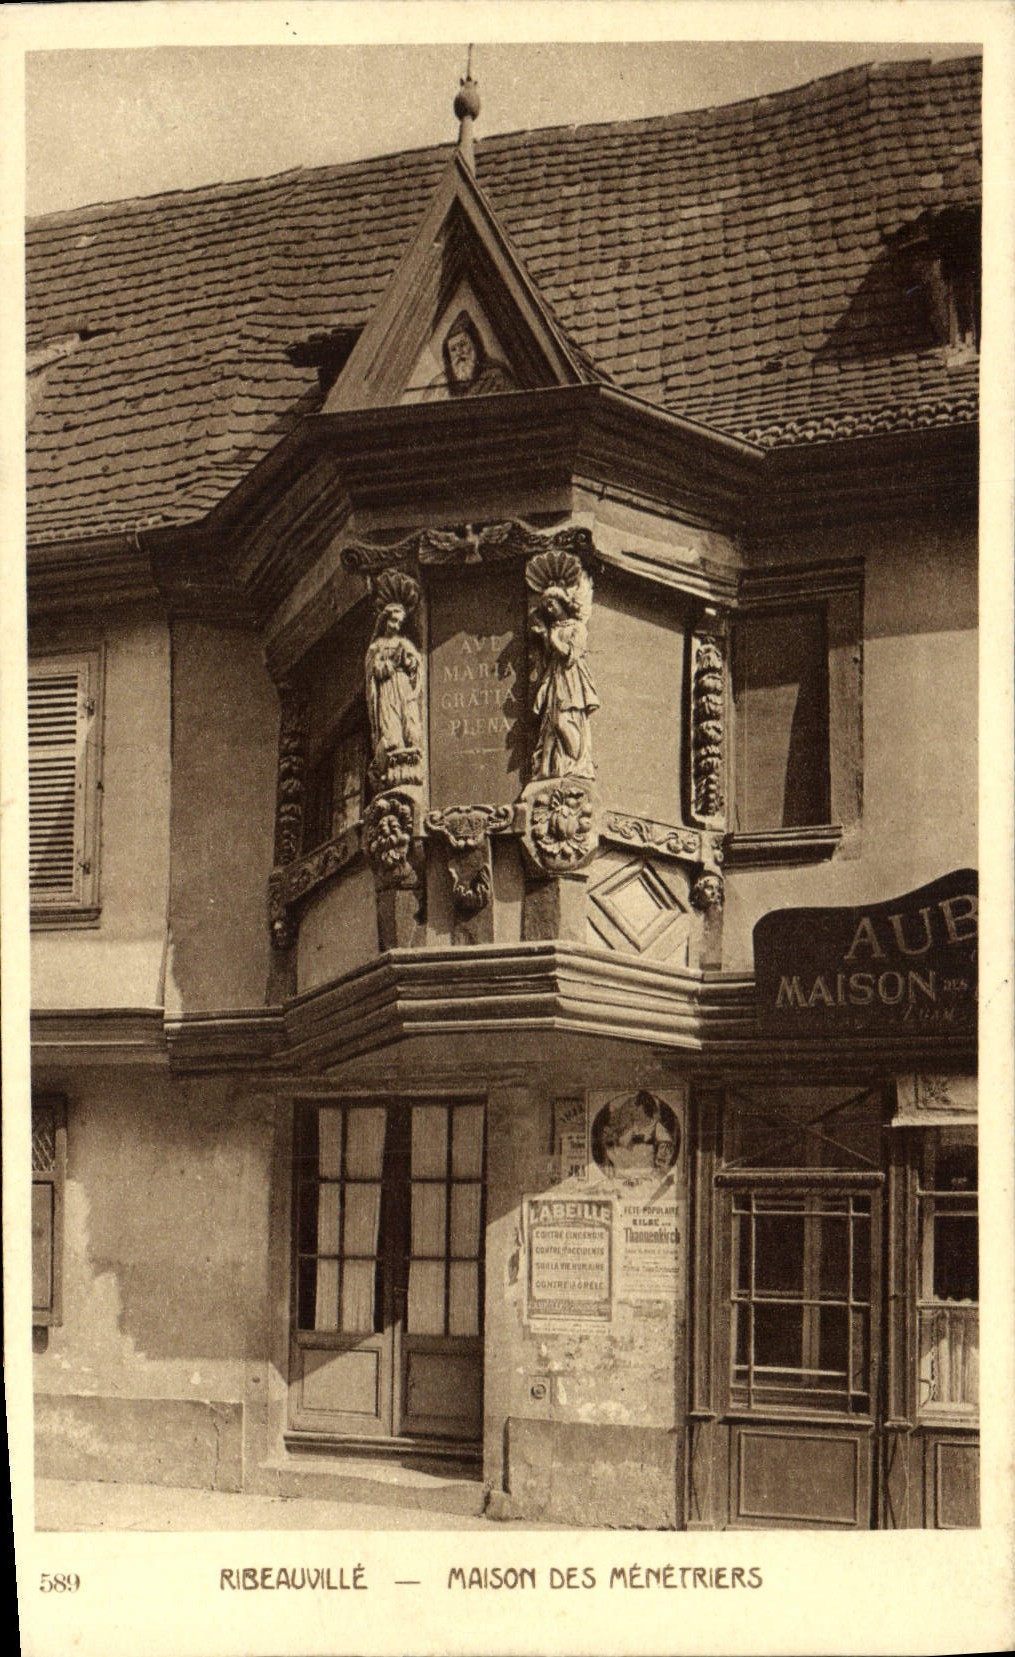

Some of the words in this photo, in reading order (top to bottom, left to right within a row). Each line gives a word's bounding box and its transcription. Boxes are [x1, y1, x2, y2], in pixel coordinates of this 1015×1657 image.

[461, 635, 501, 653] AVE
[442, 661, 516, 681] MARIA
[441, 688, 517, 709] GRATIA
[450, 717, 511, 736] PLENA
[775, 970, 936, 1008] MAISON
